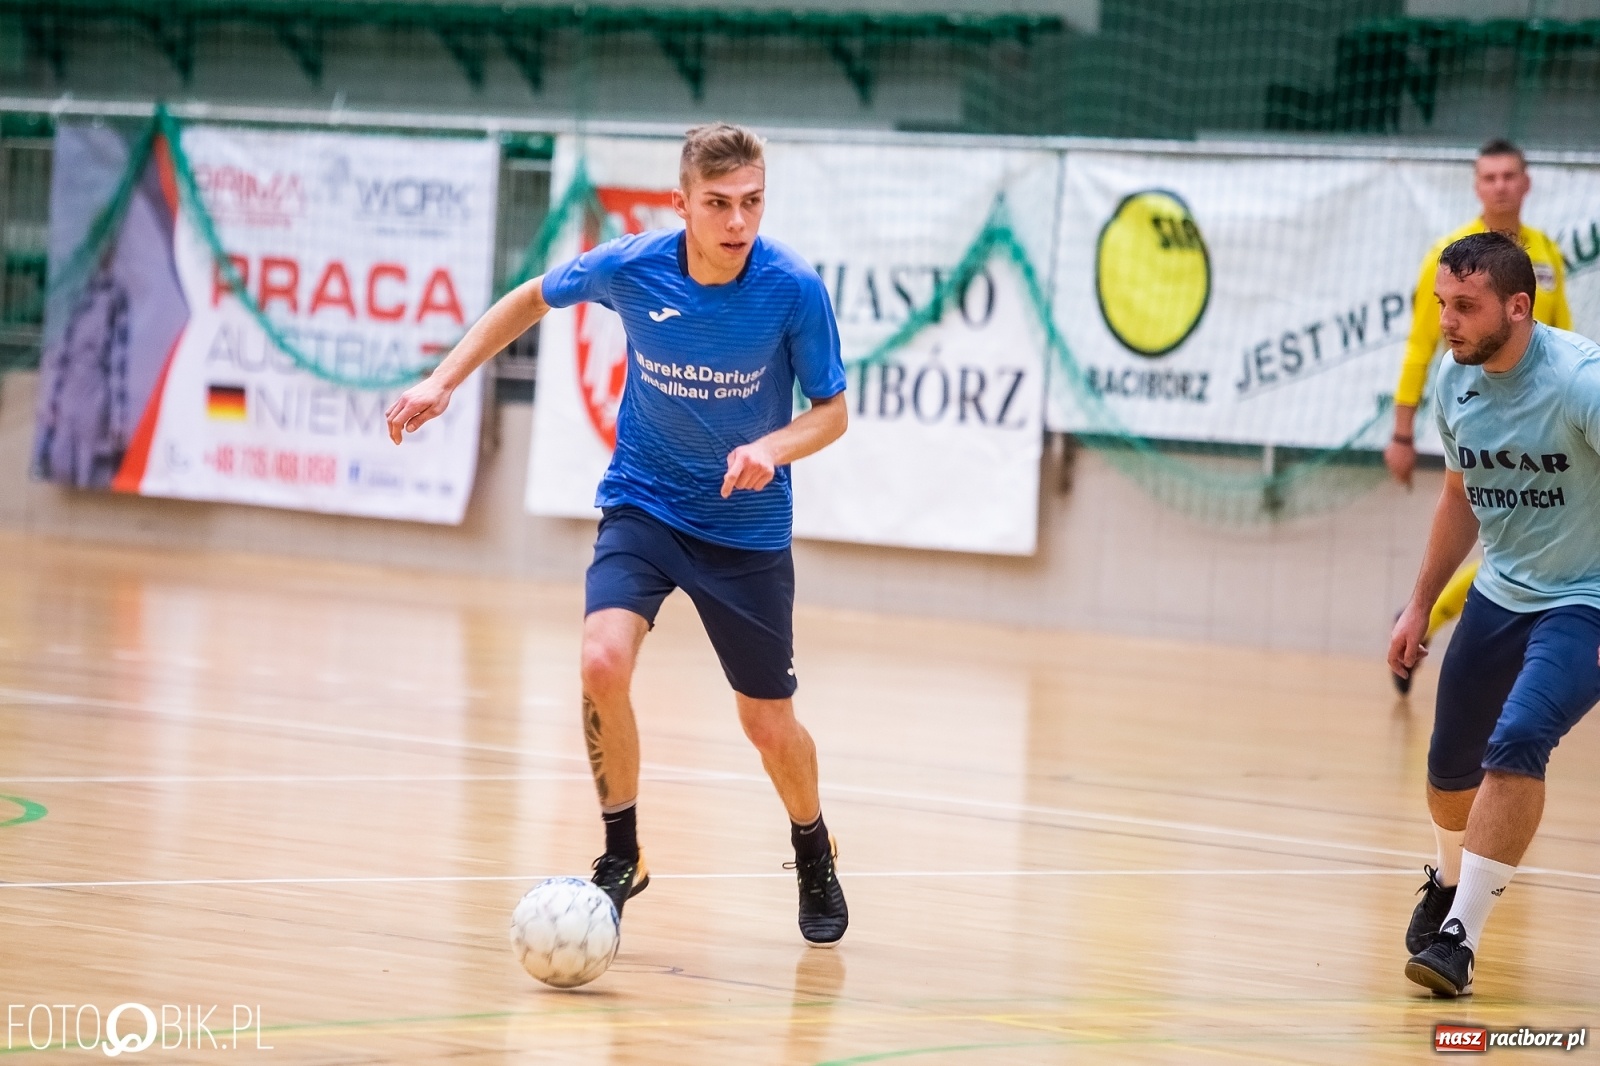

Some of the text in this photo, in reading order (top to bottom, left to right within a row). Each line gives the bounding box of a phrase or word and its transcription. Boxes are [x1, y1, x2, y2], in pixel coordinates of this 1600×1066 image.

[355, 174, 472, 222] WORK
[210, 255, 464, 325] PRACA
[204, 322, 414, 383] AUSTRIA
[635, 349, 767, 385] Marek&Dariusz
[1236, 318, 1324, 395] JEST
[1335, 303, 1368, 350] W
[255, 382, 466, 446] NIEMY
[856, 343, 1025, 430] IBÓRZ
[1458, 446, 1570, 474] DICAR
